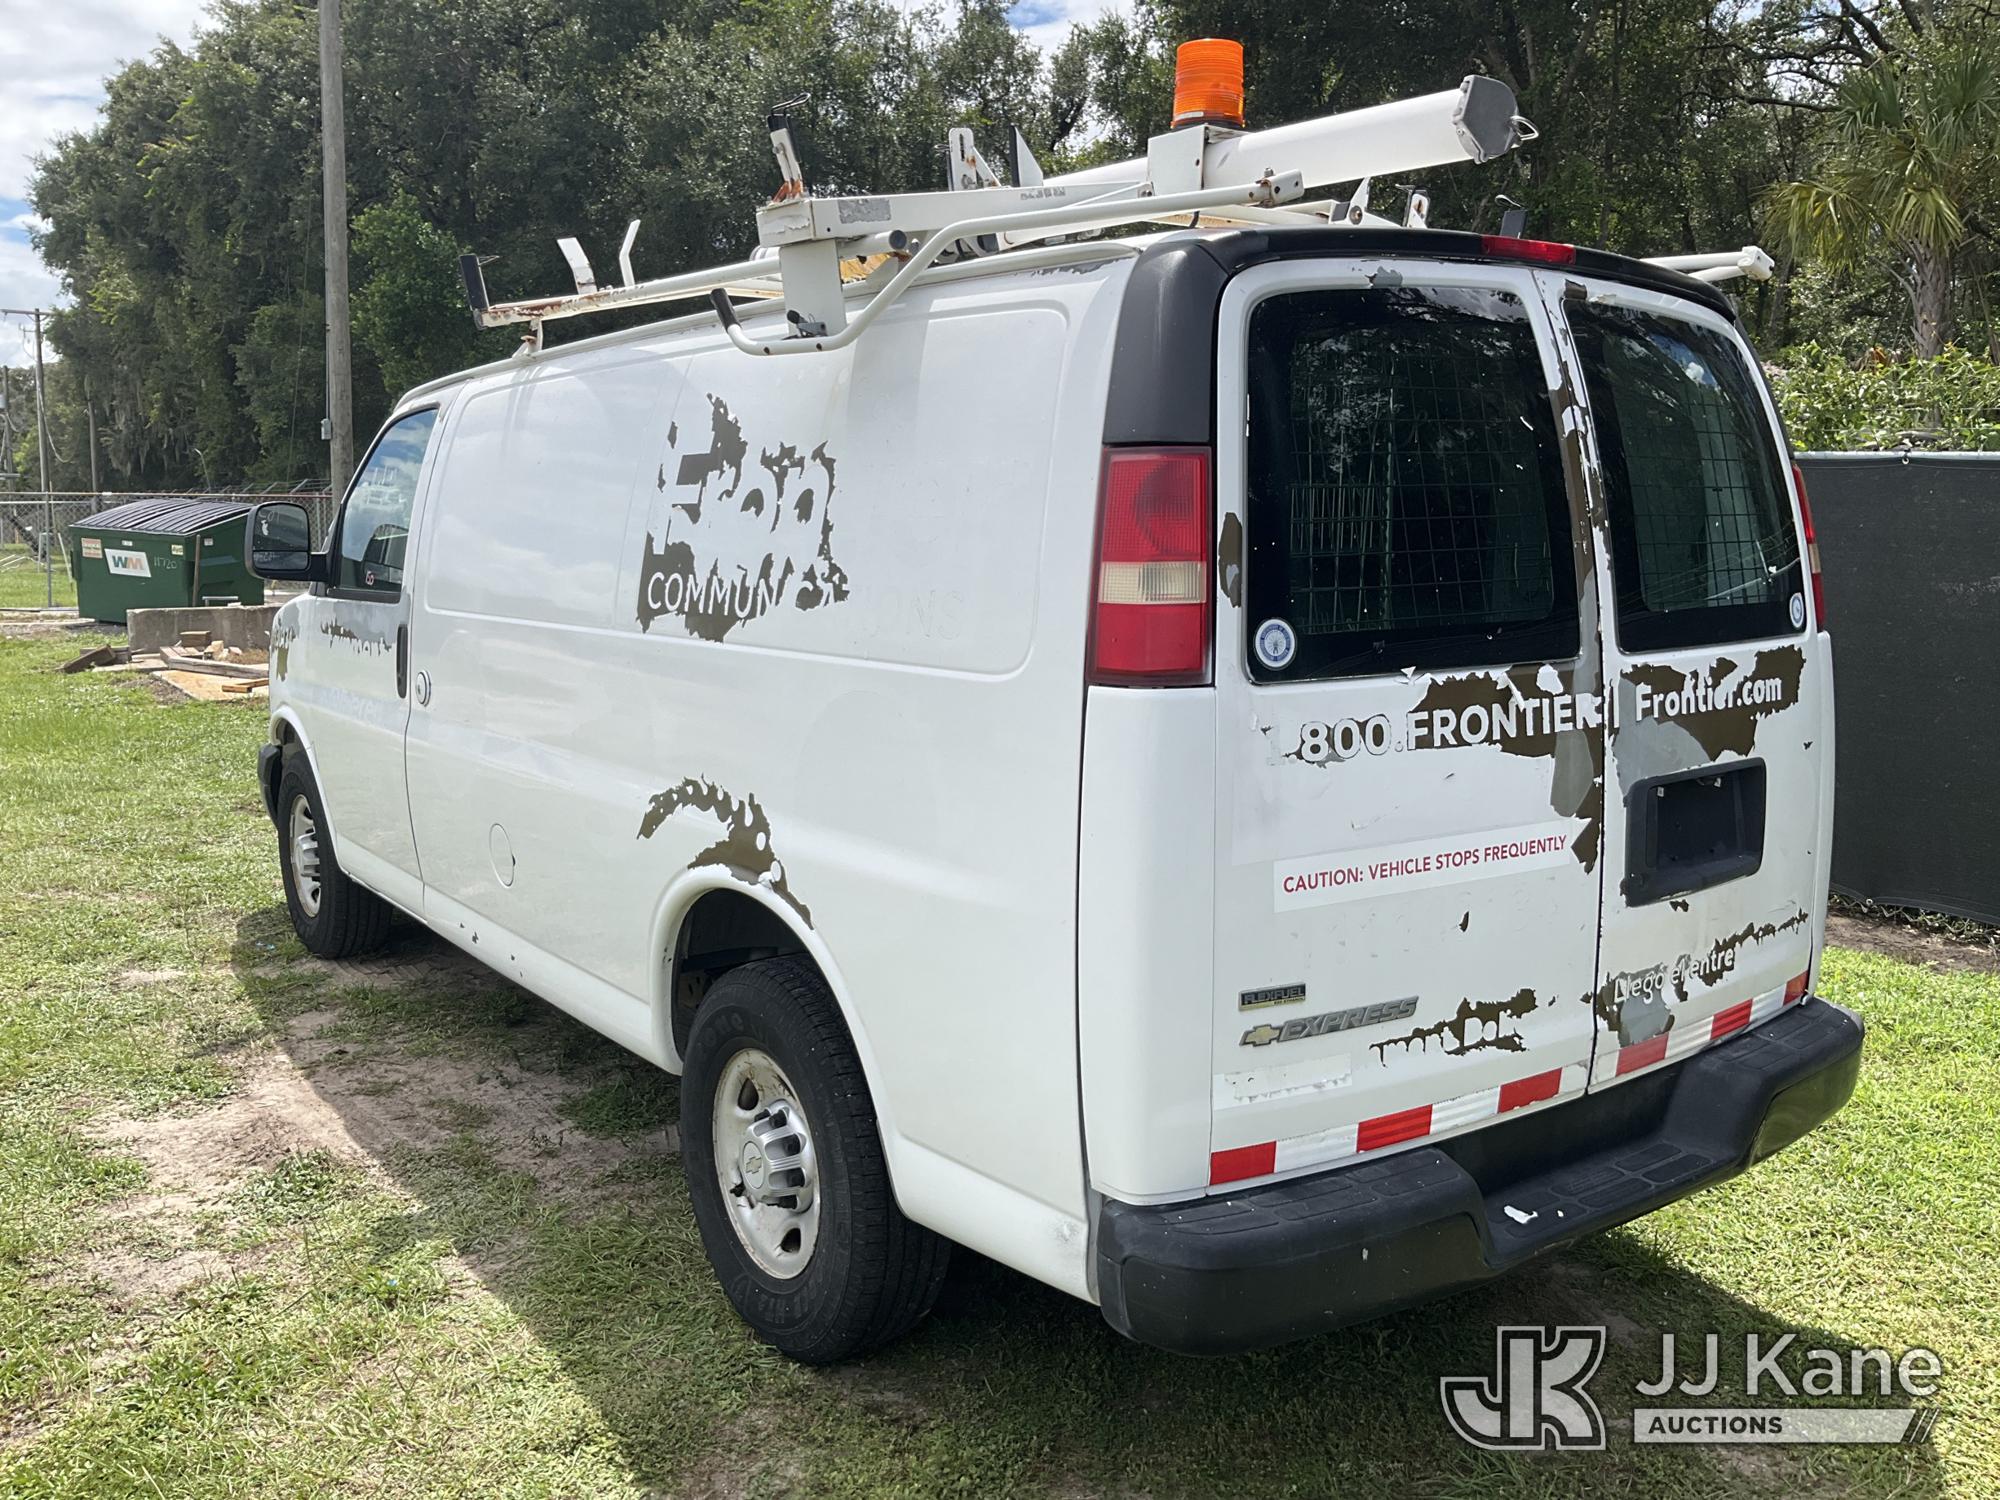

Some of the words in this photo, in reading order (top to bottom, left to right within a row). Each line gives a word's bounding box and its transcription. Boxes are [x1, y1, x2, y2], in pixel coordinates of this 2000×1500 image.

[112, 555, 144, 570] WM
[1283, 867, 1363, 893] CAUTION:
[1368, 857, 1431, 880] VEHICLE
[1435, 849, 1480, 870] STOPS
[1484, 835, 1567, 862] FREQUENTLY
[1278, 998, 1419, 1043] EXPRESS
